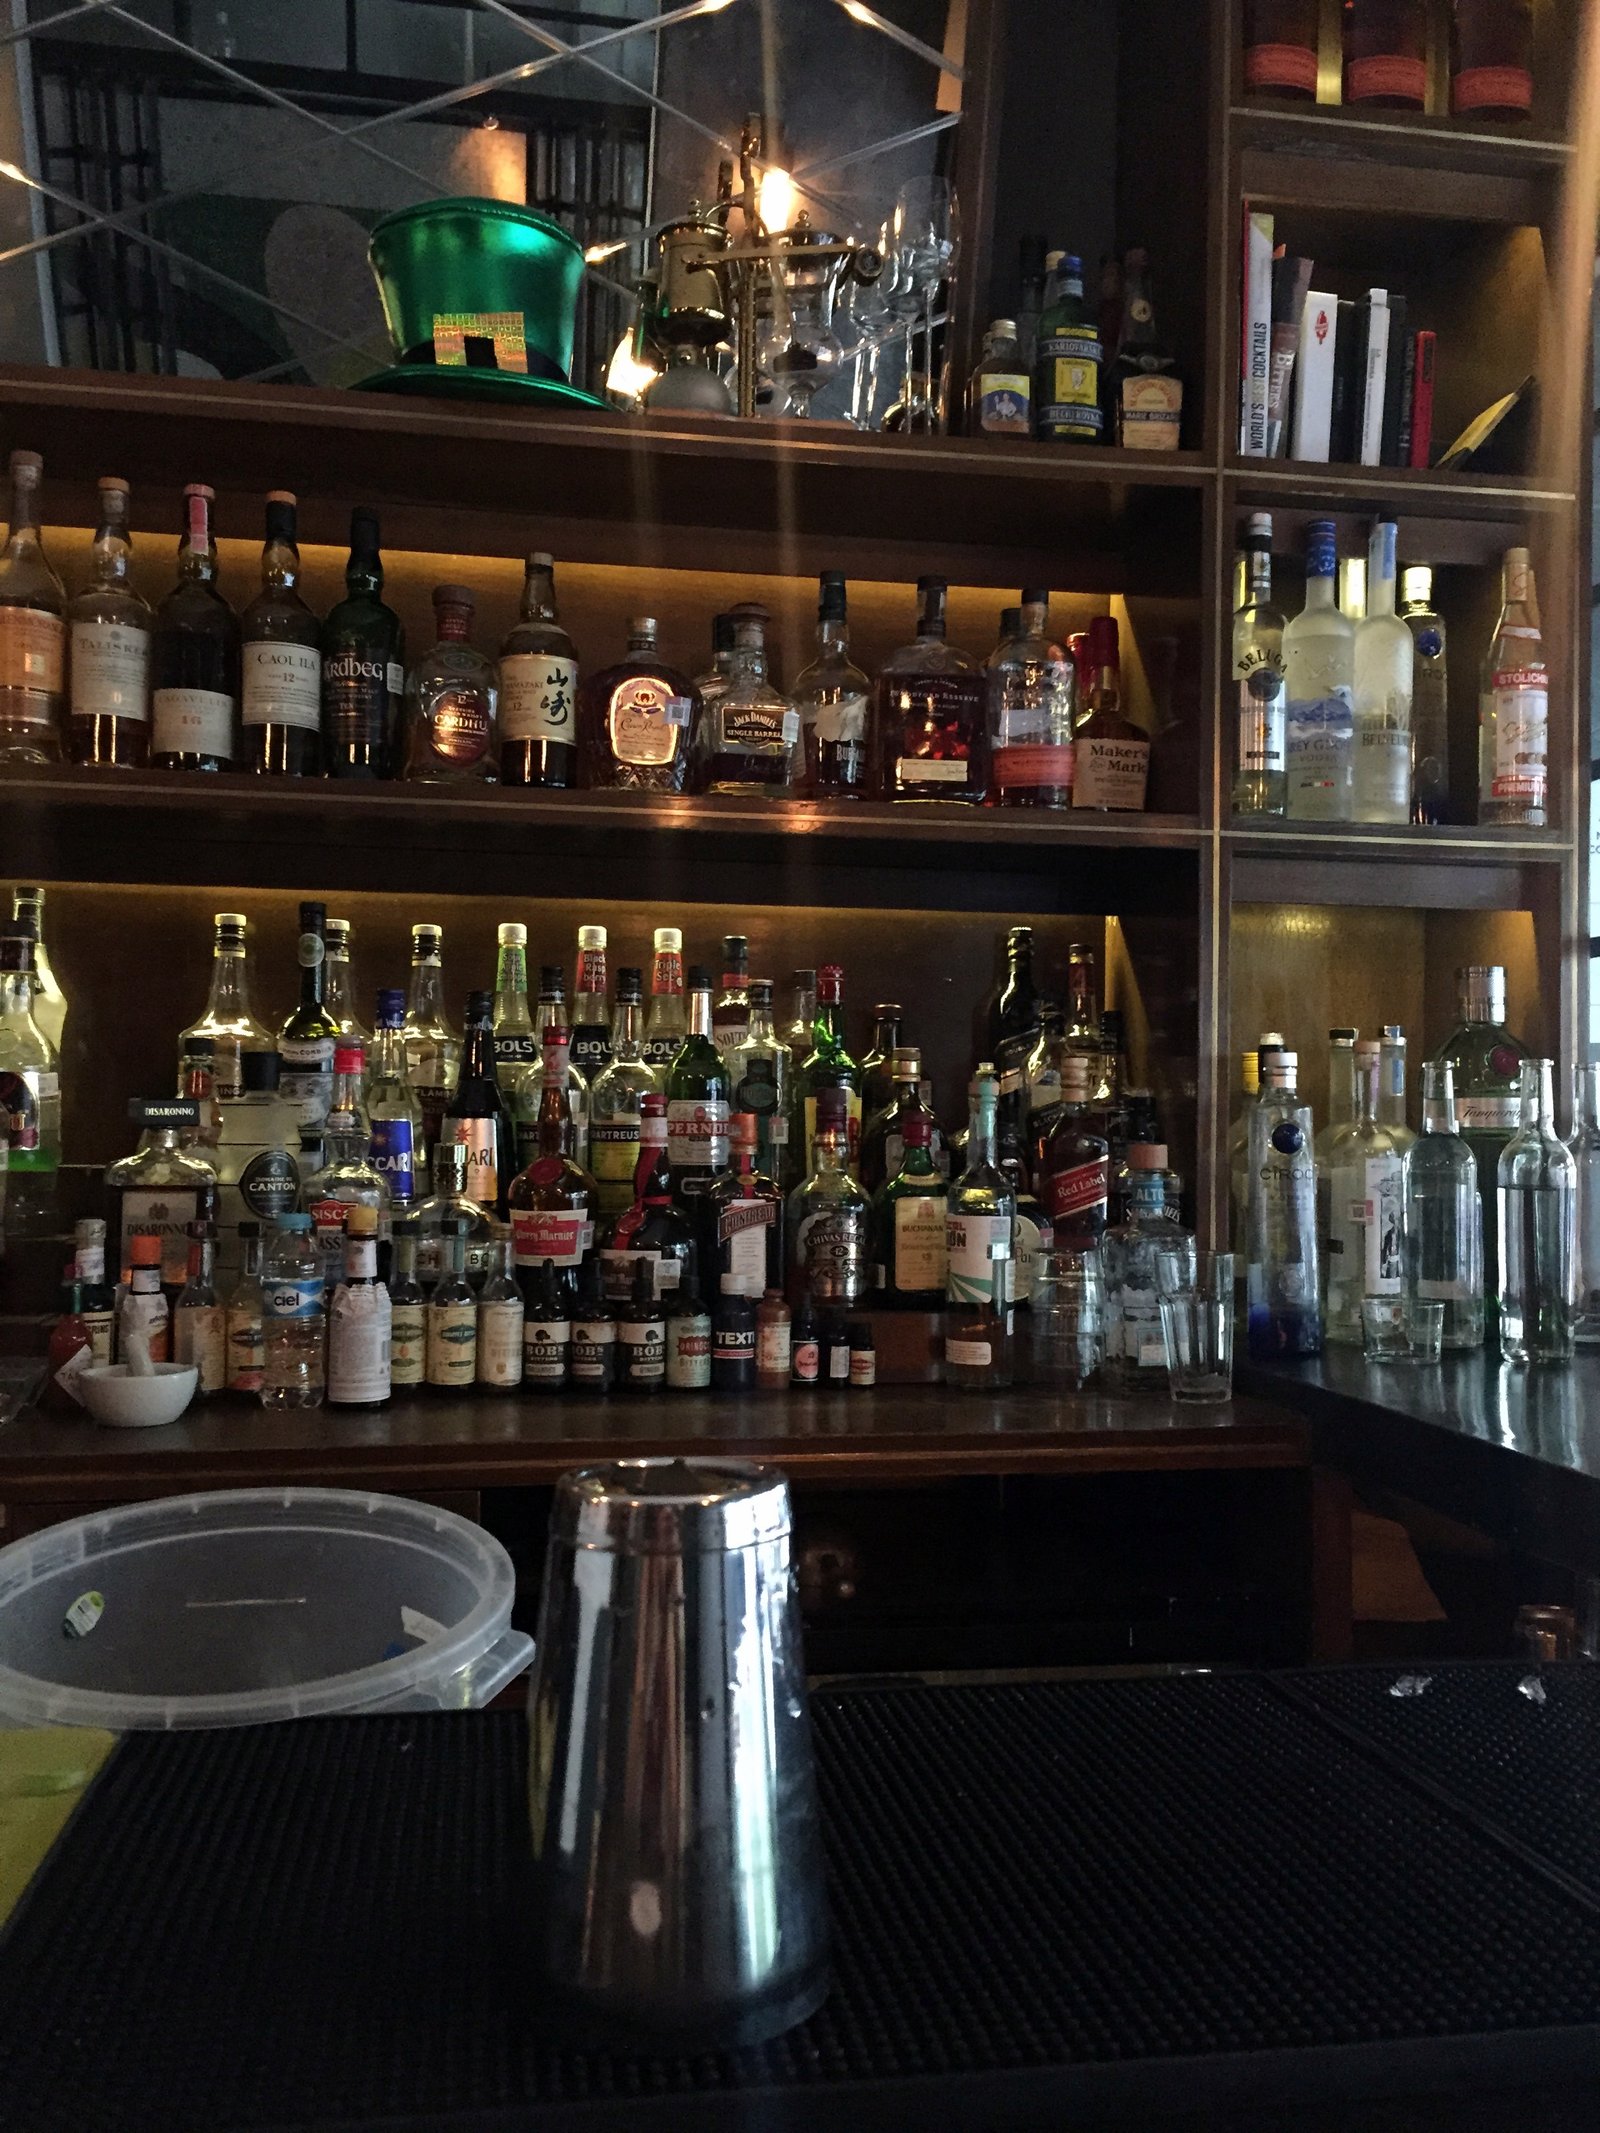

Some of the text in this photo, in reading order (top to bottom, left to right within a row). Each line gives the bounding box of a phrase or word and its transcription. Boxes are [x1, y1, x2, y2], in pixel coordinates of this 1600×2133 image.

[1252, 323, 1267, 378] COCKTAILS
[1270, 352, 1296, 409] BITTERS
[1251, 403, 1265, 449] WORLD'S
[257, 653, 316, 671] CAOL ILA
[1237, 649, 1288, 673] BELUGA
[283, 672, 295, 683] 12
[513, 702, 523, 712] 12
[434, 714, 488, 731] CARDHU
[734, 714, 751, 728] JACK
[727, 729, 754, 737] SINGLE
[1090, 744, 1148, 759] Maker's
[1108, 760, 1146, 774] Mark
[655, 959, 681, 971] Triple
[657, 971, 675, 981] Sec
[145, 1107, 195, 1117] DISARONNO
[467, 1147, 493, 1167] ARI
[250, 1182, 296, 1192] CANTON
[1057, 1173, 1105, 1198] Red Label
[724, 1206, 775, 1233] COINTREAU
[539, 1229, 575, 1241] Marnier
[807, 1233, 841, 1246] CHIVAS
[274, 1292, 300, 1306] ciel
